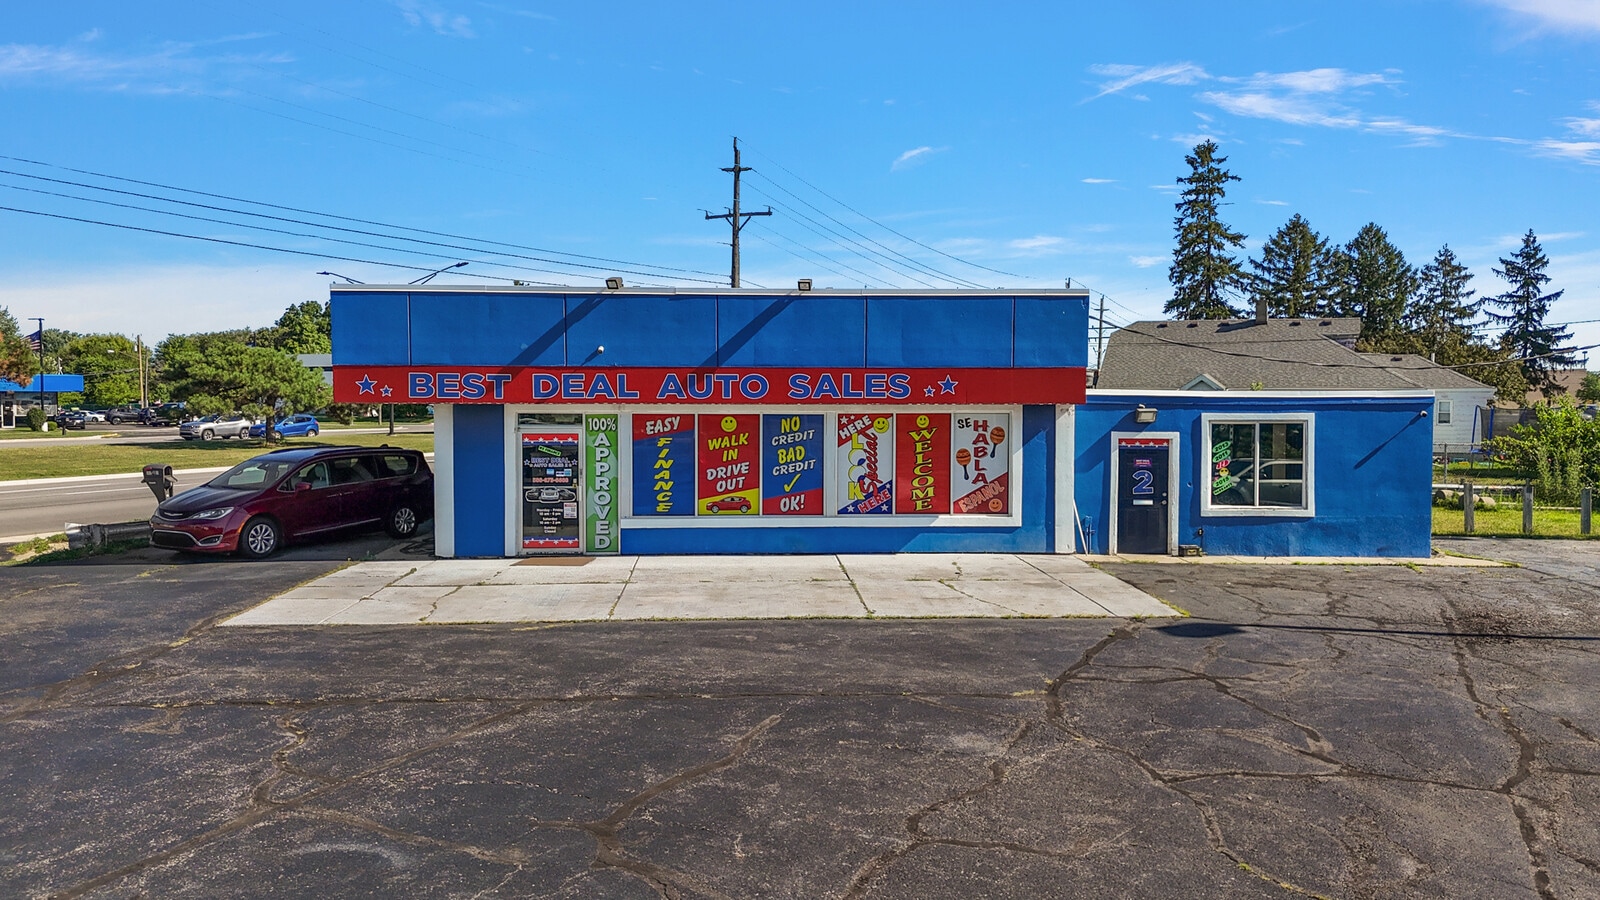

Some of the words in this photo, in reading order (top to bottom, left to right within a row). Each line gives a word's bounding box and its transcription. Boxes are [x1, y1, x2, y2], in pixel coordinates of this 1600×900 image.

[408, 372, 512, 399] BEST
[532, 373, 640, 400] DEAL
[656, 373, 770, 400] AUTO
[787, 373, 912, 400] SALES
[588, 417, 616, 431] 100%
[645, 416, 681, 435] EASY
[781, 415, 801, 434] NO
[838, 414, 872, 440] HERE
[957, 417, 972, 429] SE
[707, 432, 749, 450] WALK
[771, 429, 815, 446] CREDIT
[722, 448, 738, 462] IN
[777, 445, 806, 464] BAD
[972, 419, 990, 485] HABLA
[1215, 450, 1228, 462] 2011
[706, 461, 750, 481] DRIVE
[772, 459, 816, 476] CREDIT
[848, 432, 866, 500] LOOK
[858, 429, 883, 497] Special
[908, 427, 938, 512] WELCOME
[653, 437, 674, 512] FINANCE
[716, 476, 746, 492] OUT
[1132, 469, 1154, 495] 2
[594, 432, 611, 550] APPROVED
[780, 494, 805, 513] OK!
[857, 488, 891, 514] HERE
